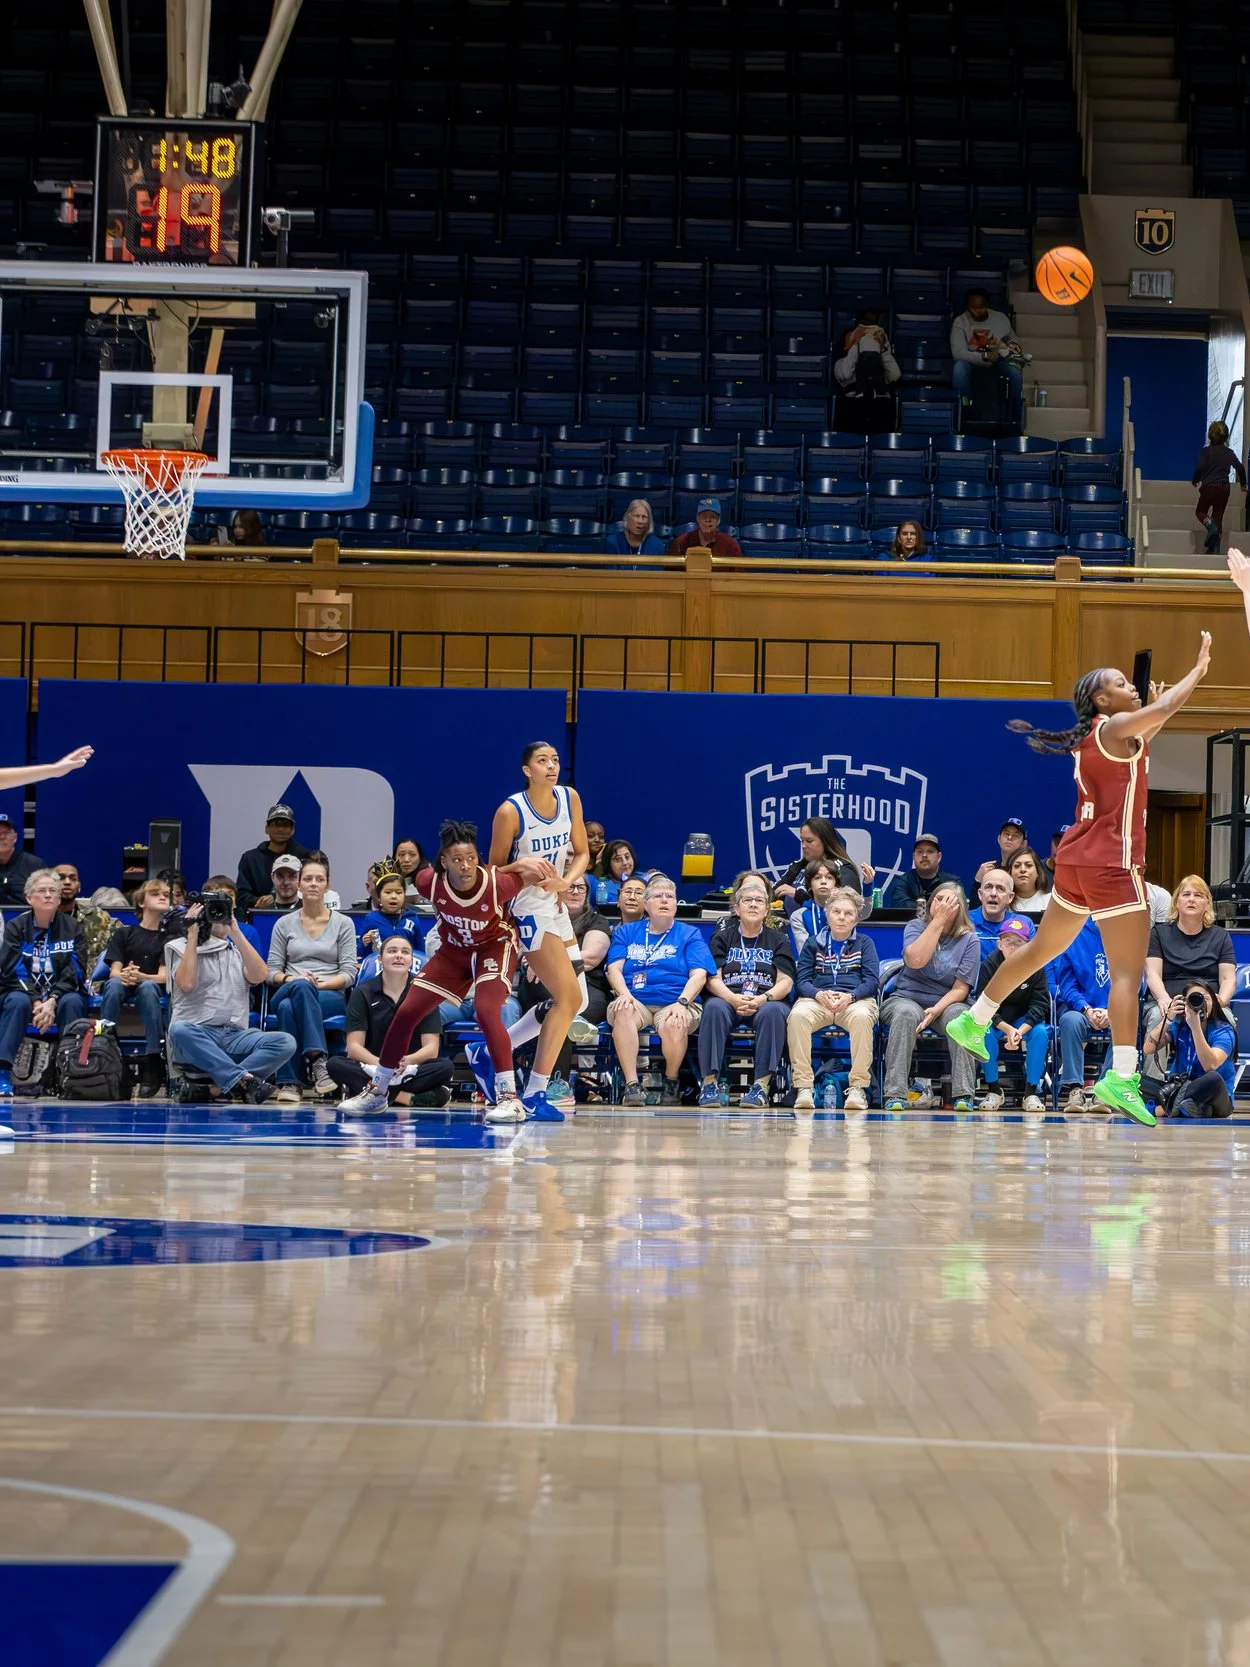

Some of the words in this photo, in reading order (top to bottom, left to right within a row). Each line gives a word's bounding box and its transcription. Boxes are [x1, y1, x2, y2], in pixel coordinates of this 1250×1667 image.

[159, 138, 236, 179] 1:48
[156, 183, 221, 253] 19
[1141, 220, 1170, 245] 10
[1138, 273, 1166, 293] EXIT
[302, 607, 343, 642] 18
[827, 777, 846, 790] THE
[760, 793, 911, 835] SISTERHOOD
[531, 831, 569, 853] DUKE
